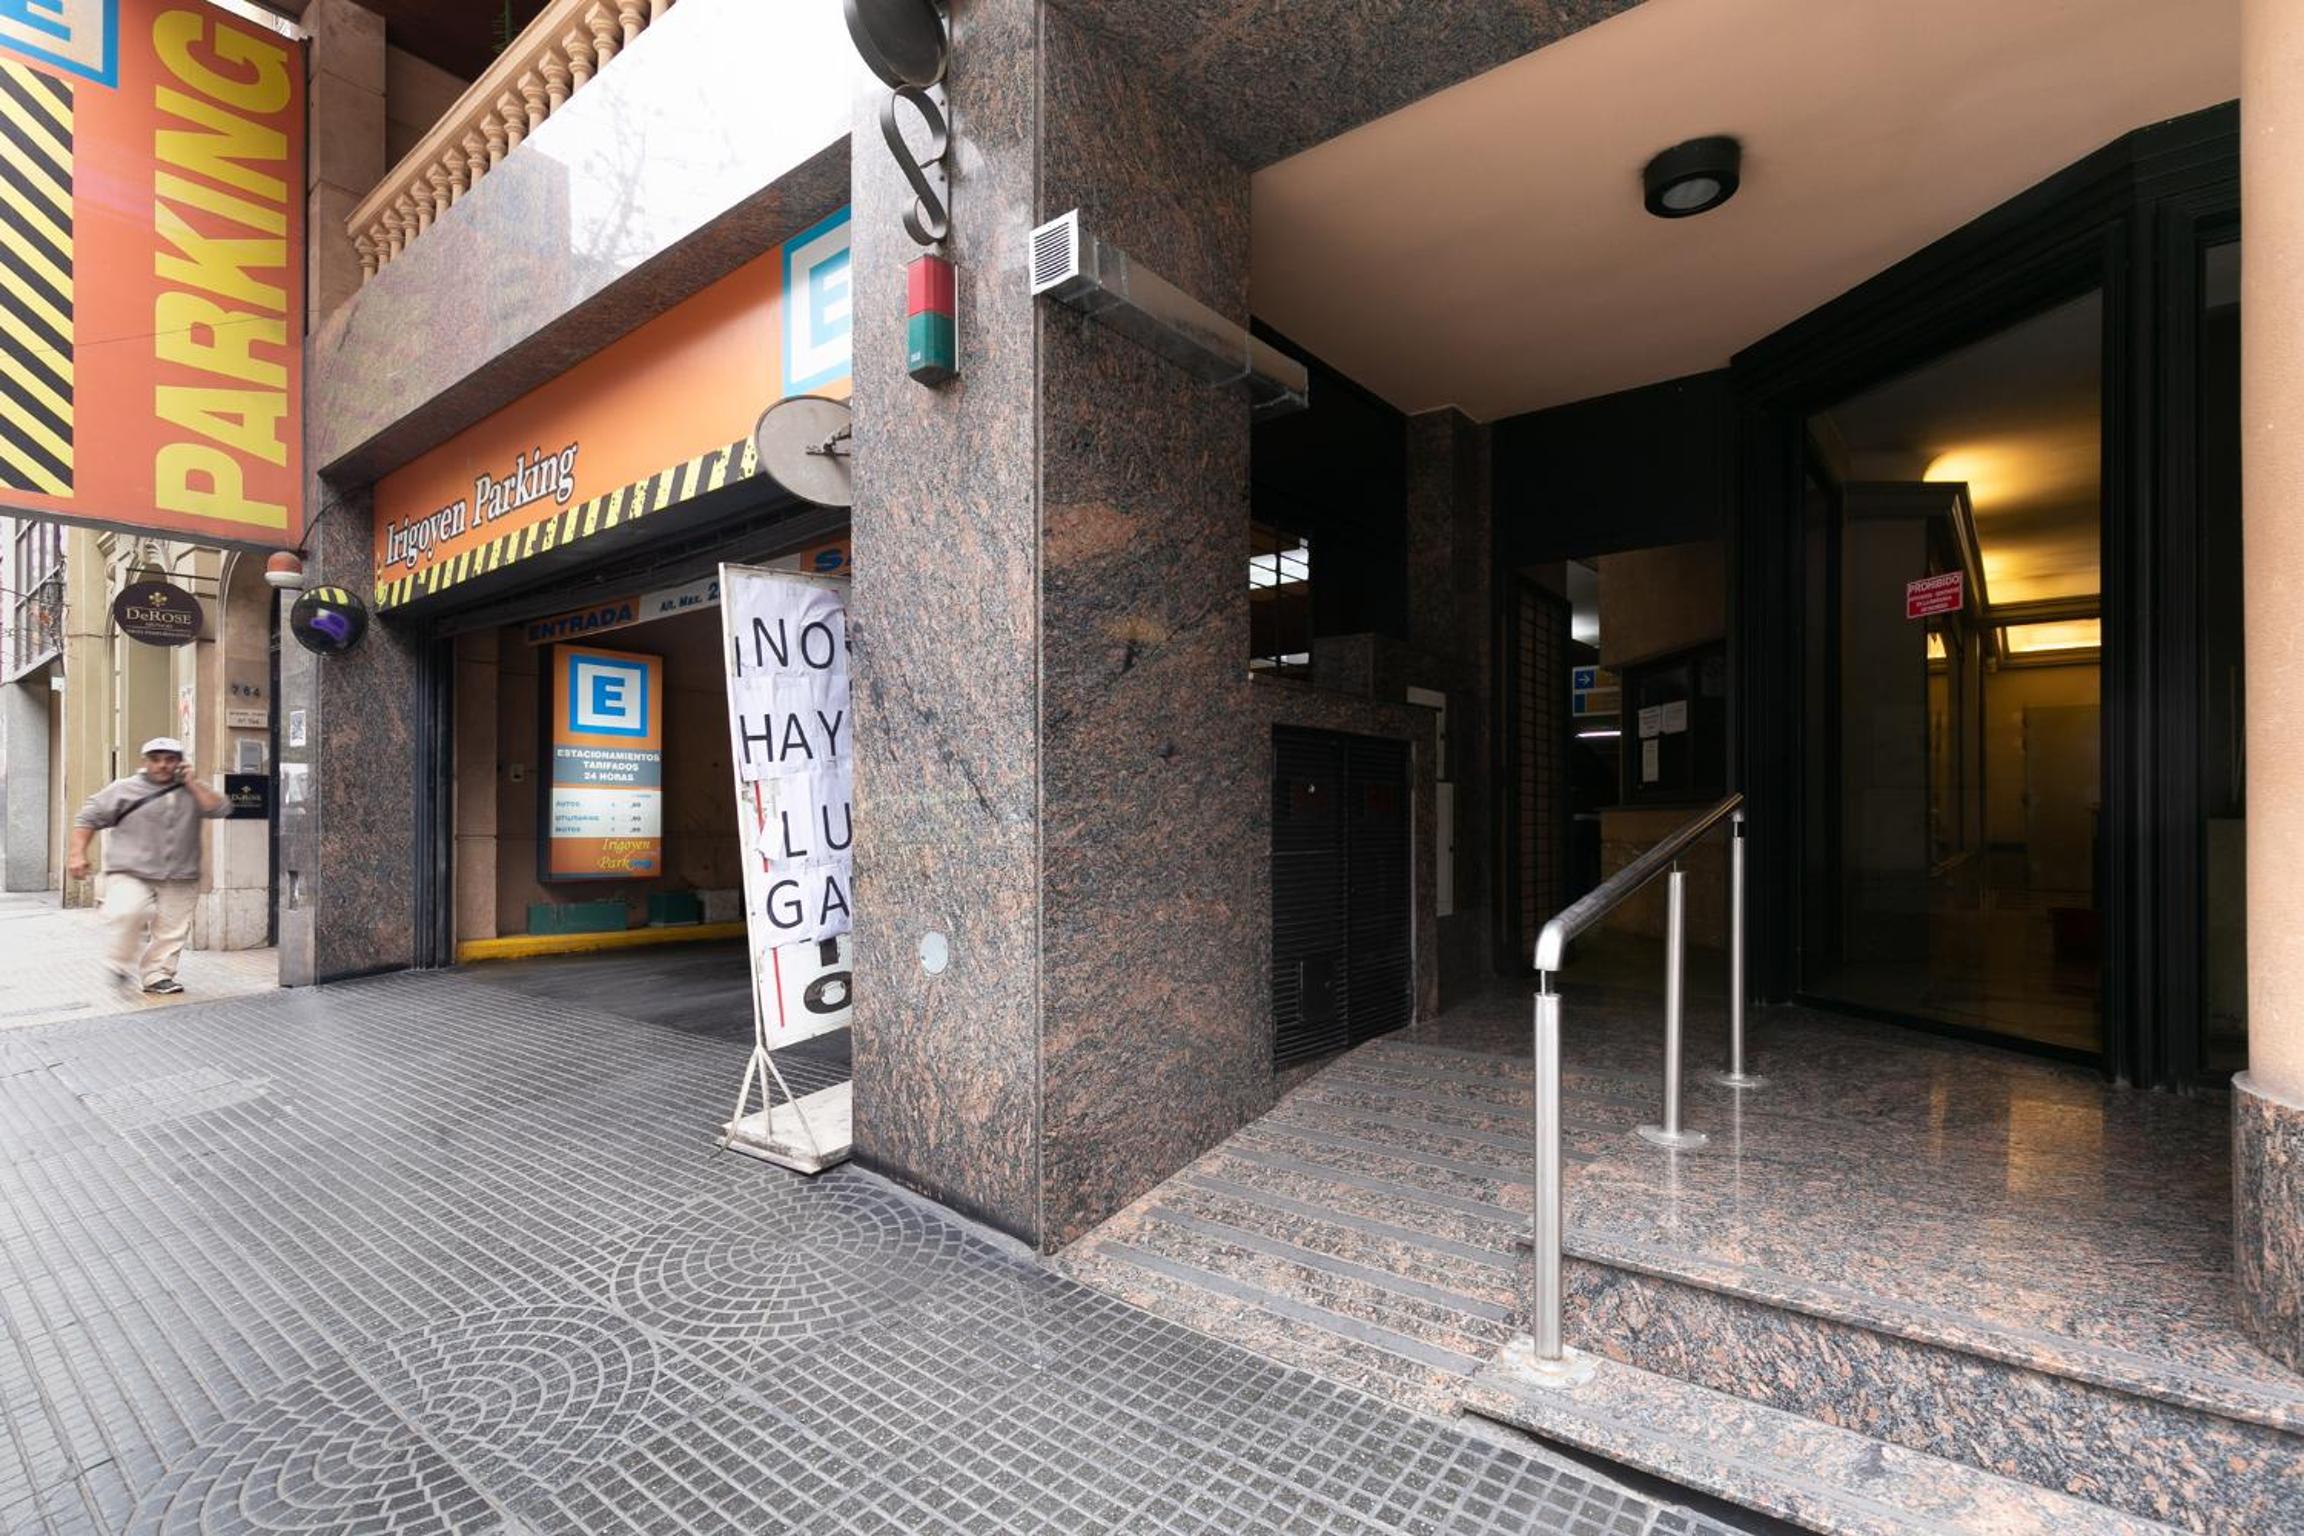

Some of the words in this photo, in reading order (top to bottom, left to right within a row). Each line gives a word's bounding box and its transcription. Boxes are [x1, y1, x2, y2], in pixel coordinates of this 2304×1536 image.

[153, 10, 291, 529] PARKING
[385, 497, 466, 569] Irigoyen
[471, 441, 579, 528] Parking
[814, 548, 851, 573] S
[528, 603, 632, 641] ENTRADA
[592, 675, 626, 716] E
[556, 749, 660, 762] ESTACIONAMIENTOS
[739, 709, 843, 765] HAY
[583, 760, 640, 772] TARIFADOS
[583, 771, 598, 780] 24
[600, 772, 635, 782] HORAS
[766, 874, 852, 930] GA
